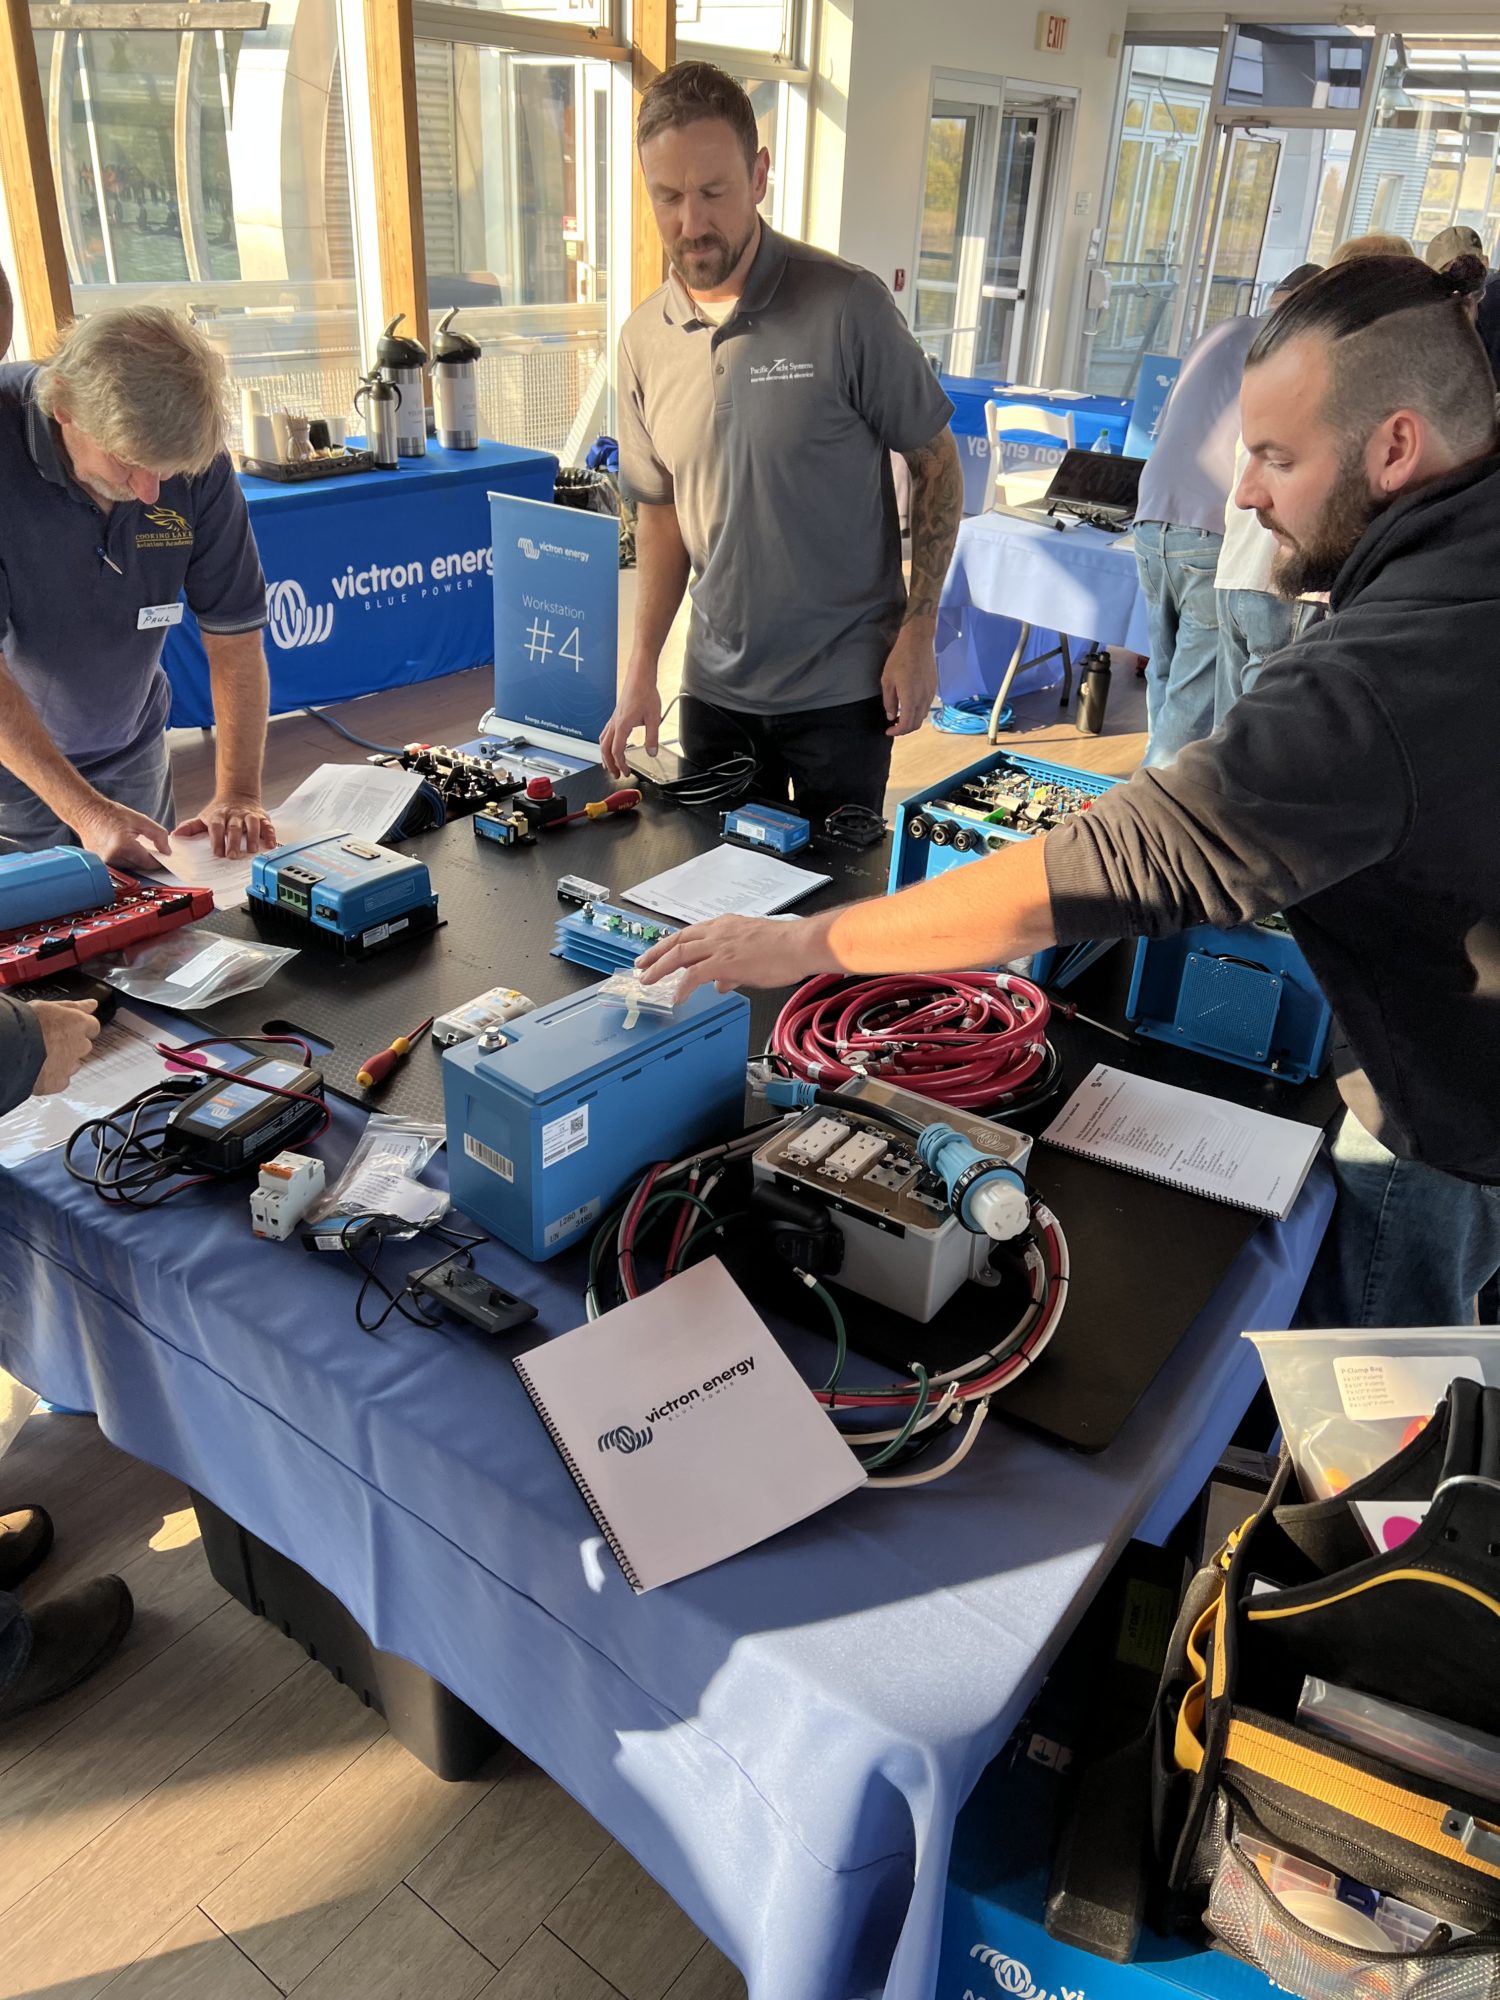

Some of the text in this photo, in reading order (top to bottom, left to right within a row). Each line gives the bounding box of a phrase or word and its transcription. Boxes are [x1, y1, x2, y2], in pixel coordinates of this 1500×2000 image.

[1047, 15, 1067, 49] EXIT
[539, 542, 564, 554] victron
[564, 548, 590, 563] energy
[332, 546, 494, 600] victron energ
[365, 579, 473, 611] BLUE POWER
[522, 594, 586, 621] Workstation
[524, 616, 585, 673] #4
[645, 1356, 755, 1423] victron energy
